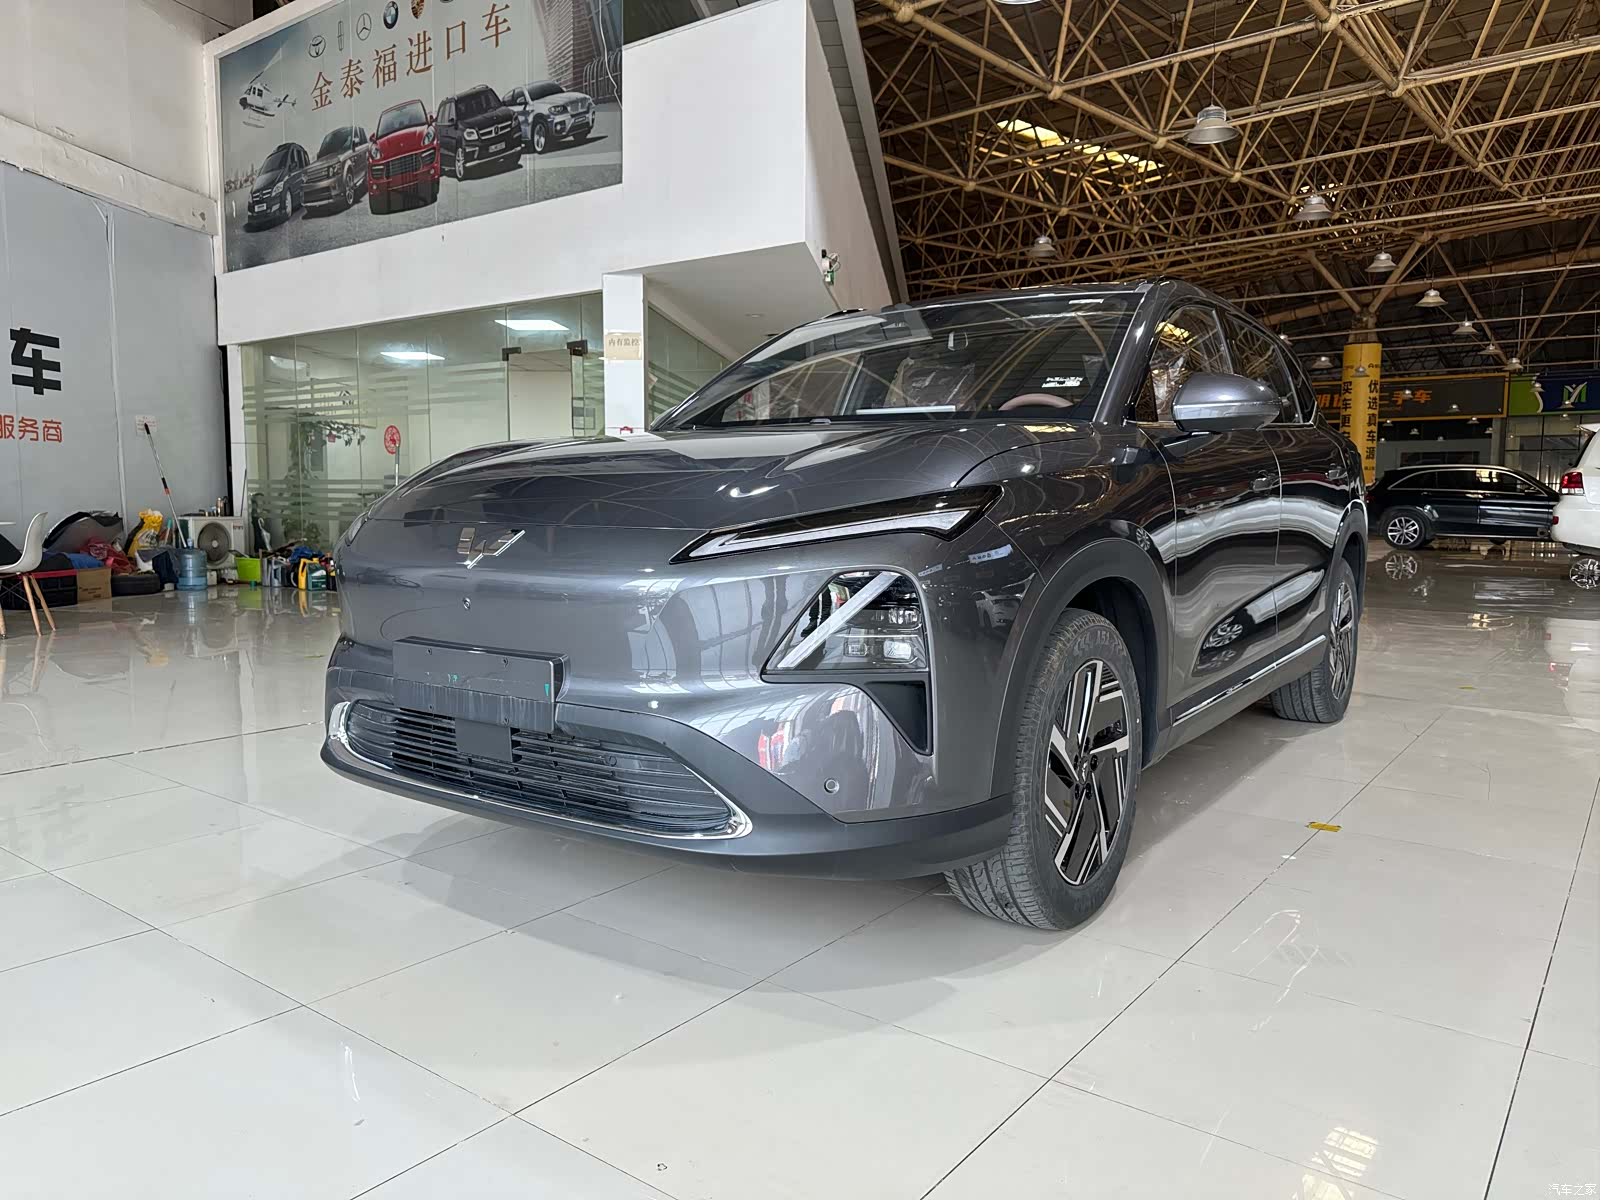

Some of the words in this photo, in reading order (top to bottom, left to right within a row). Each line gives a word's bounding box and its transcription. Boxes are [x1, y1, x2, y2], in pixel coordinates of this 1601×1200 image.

[311, 3, 511, 111] 金泰福进口车
[10, 327, 61, 395] 车
[0, 414, 63, 443] 服务商
[1365, 379, 1379, 460] 优选真车源
